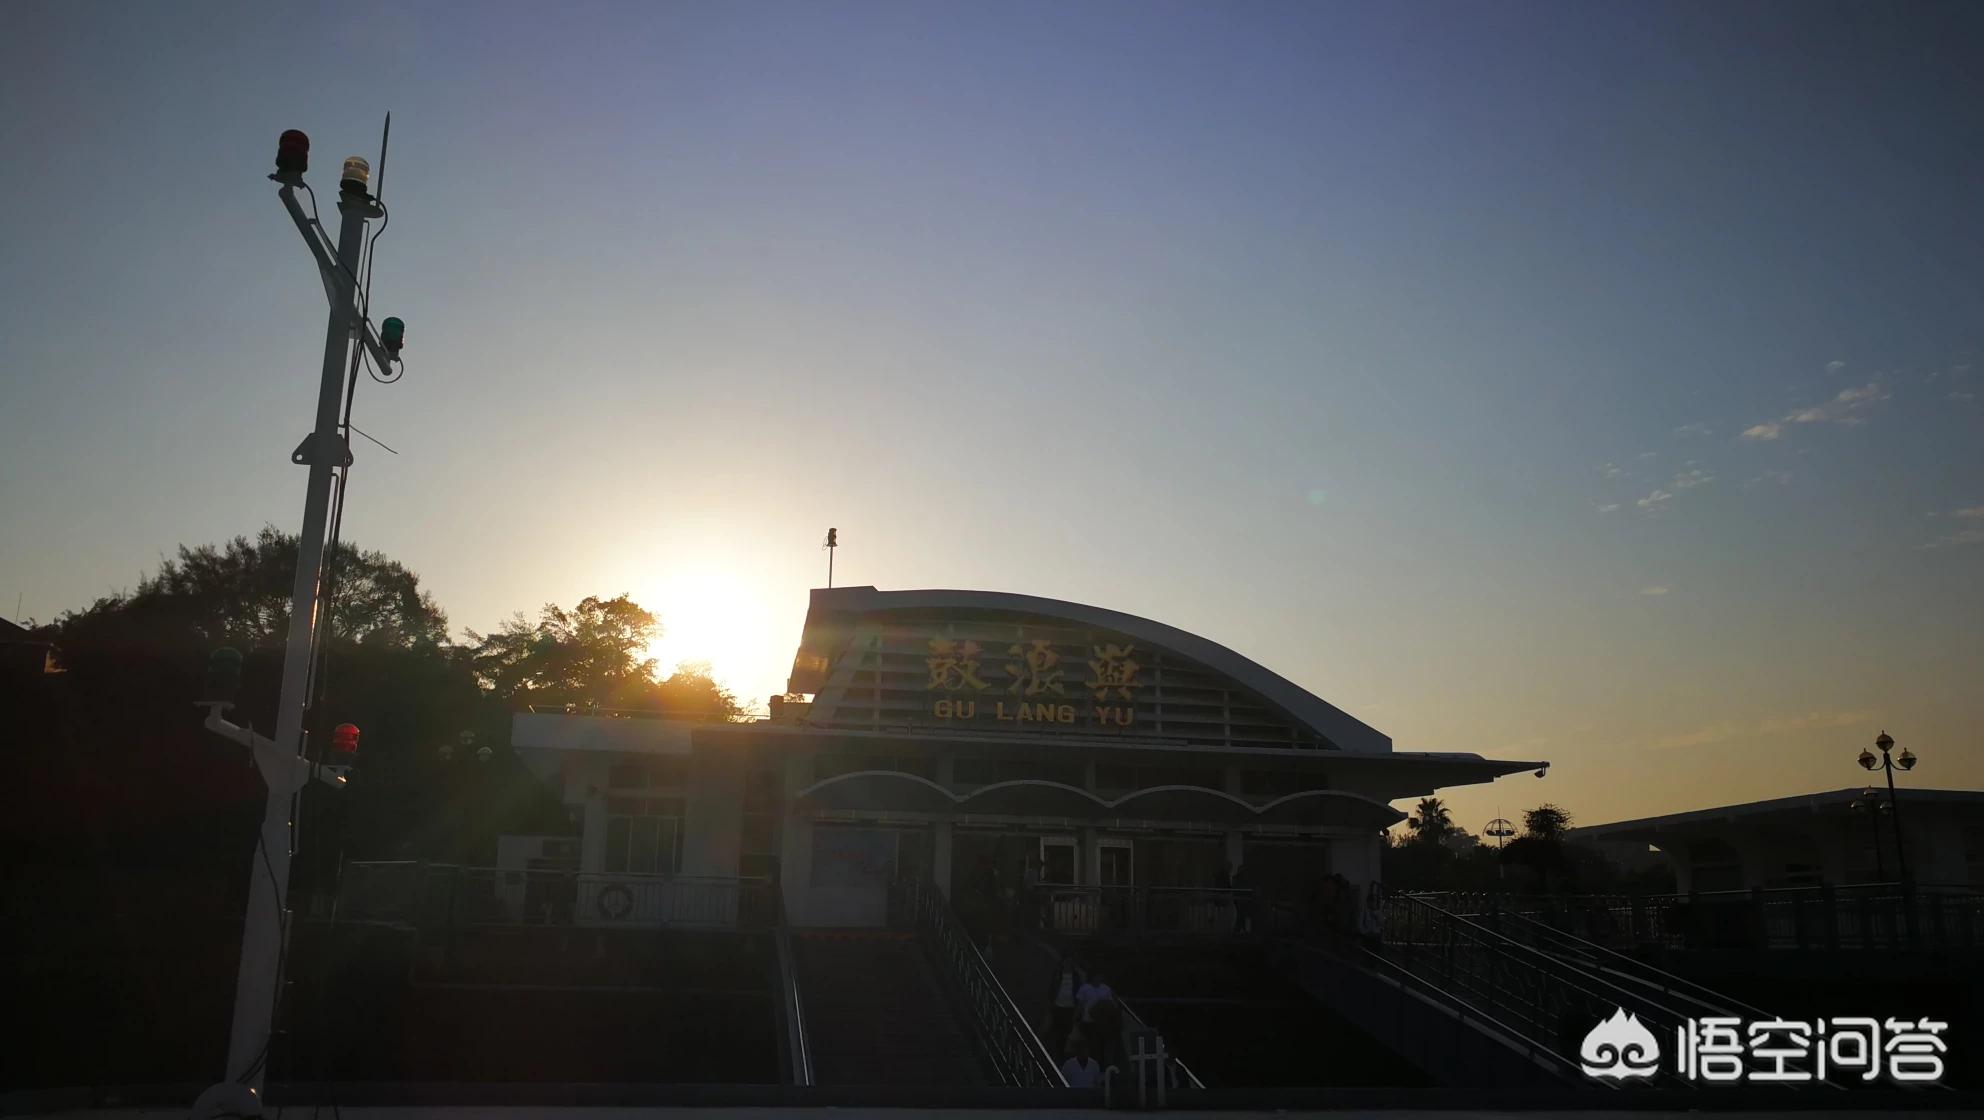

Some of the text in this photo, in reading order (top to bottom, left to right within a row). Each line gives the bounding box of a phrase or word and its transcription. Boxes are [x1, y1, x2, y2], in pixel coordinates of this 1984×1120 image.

[935, 701, 1134, 725] GU LANG YU
